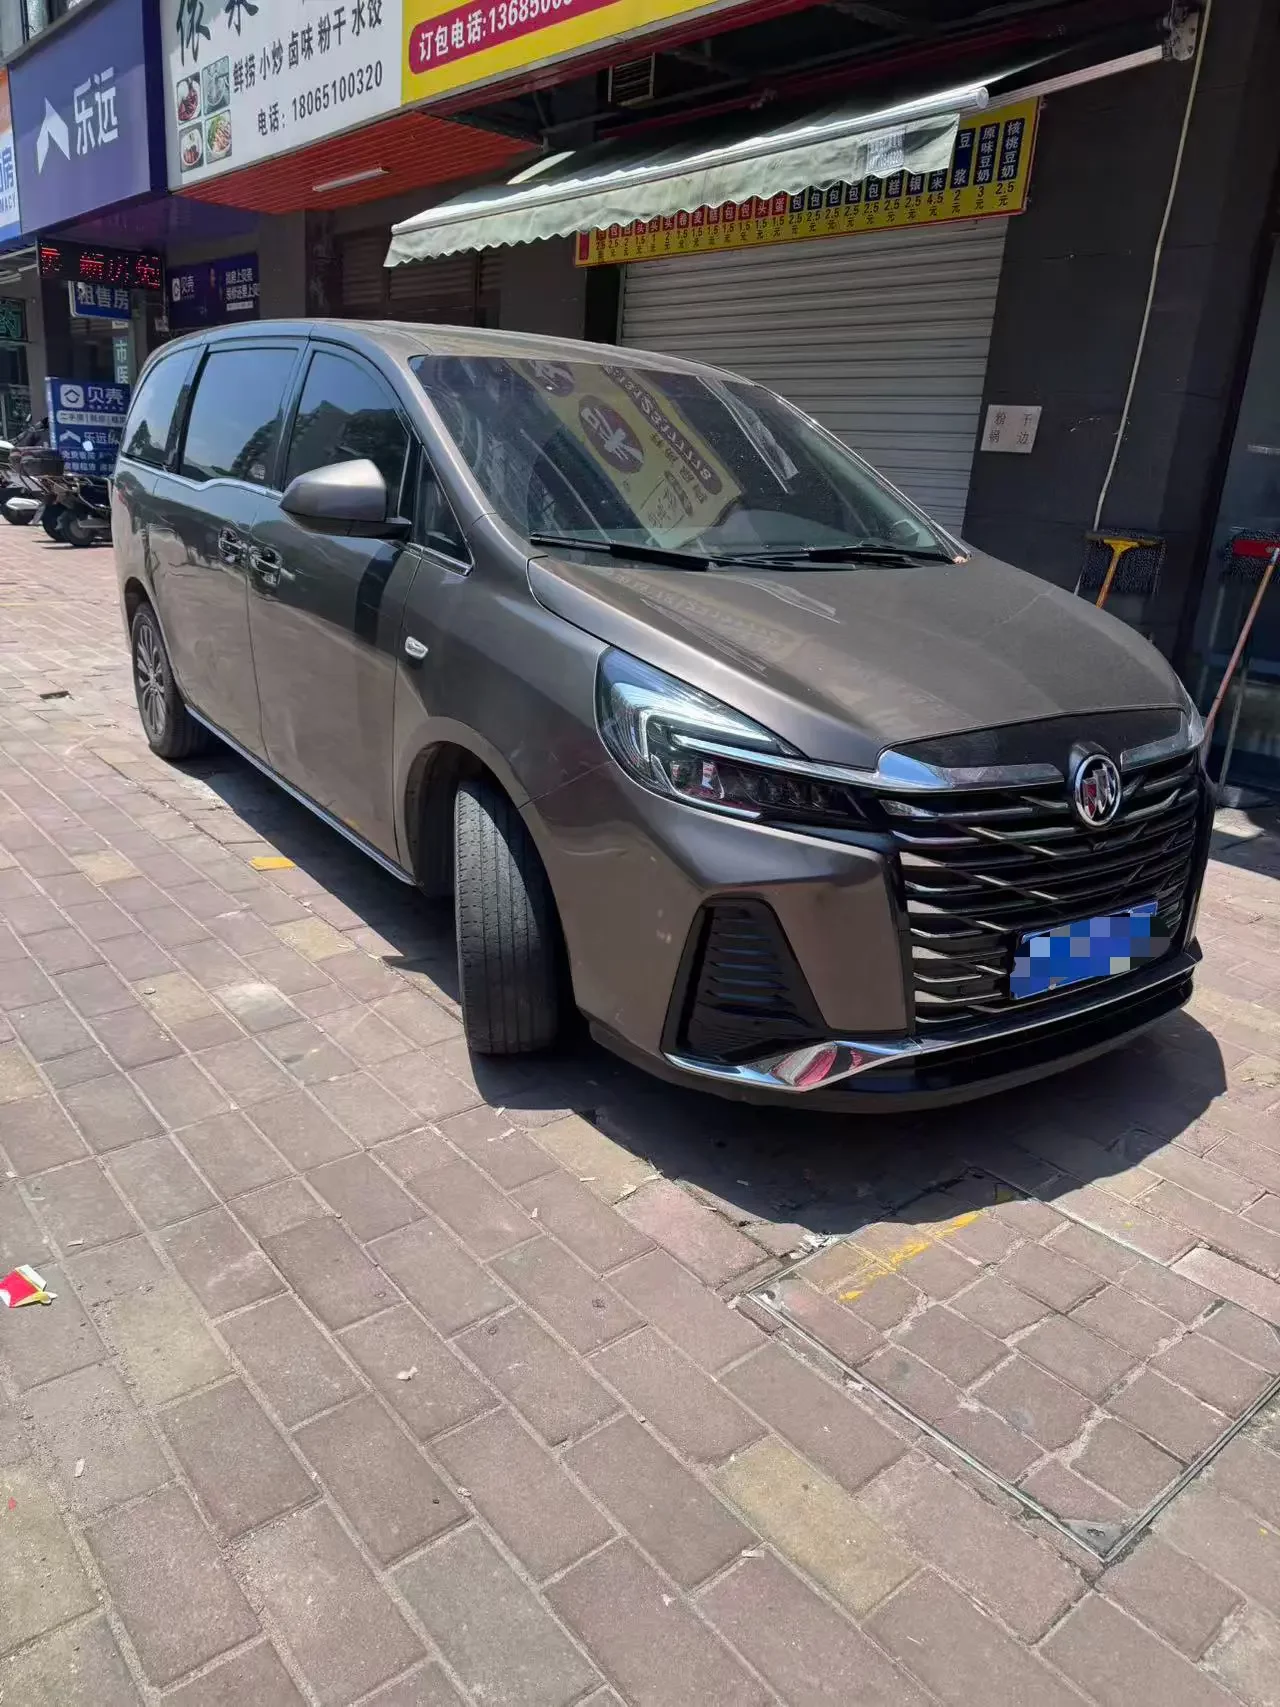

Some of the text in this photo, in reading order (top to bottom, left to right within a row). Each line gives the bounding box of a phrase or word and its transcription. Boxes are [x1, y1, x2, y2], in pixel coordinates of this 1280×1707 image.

[288, 23, 313, 69] 卤味
[318, 6, 346, 54] 粉干
[73, 66, 119, 156] 乐远
[977, 126, 996, 184] 原味豆奶
[1001, 121, 1021, 179] 核桃豆奶
[88, 386, 124, 405] 贝壳
